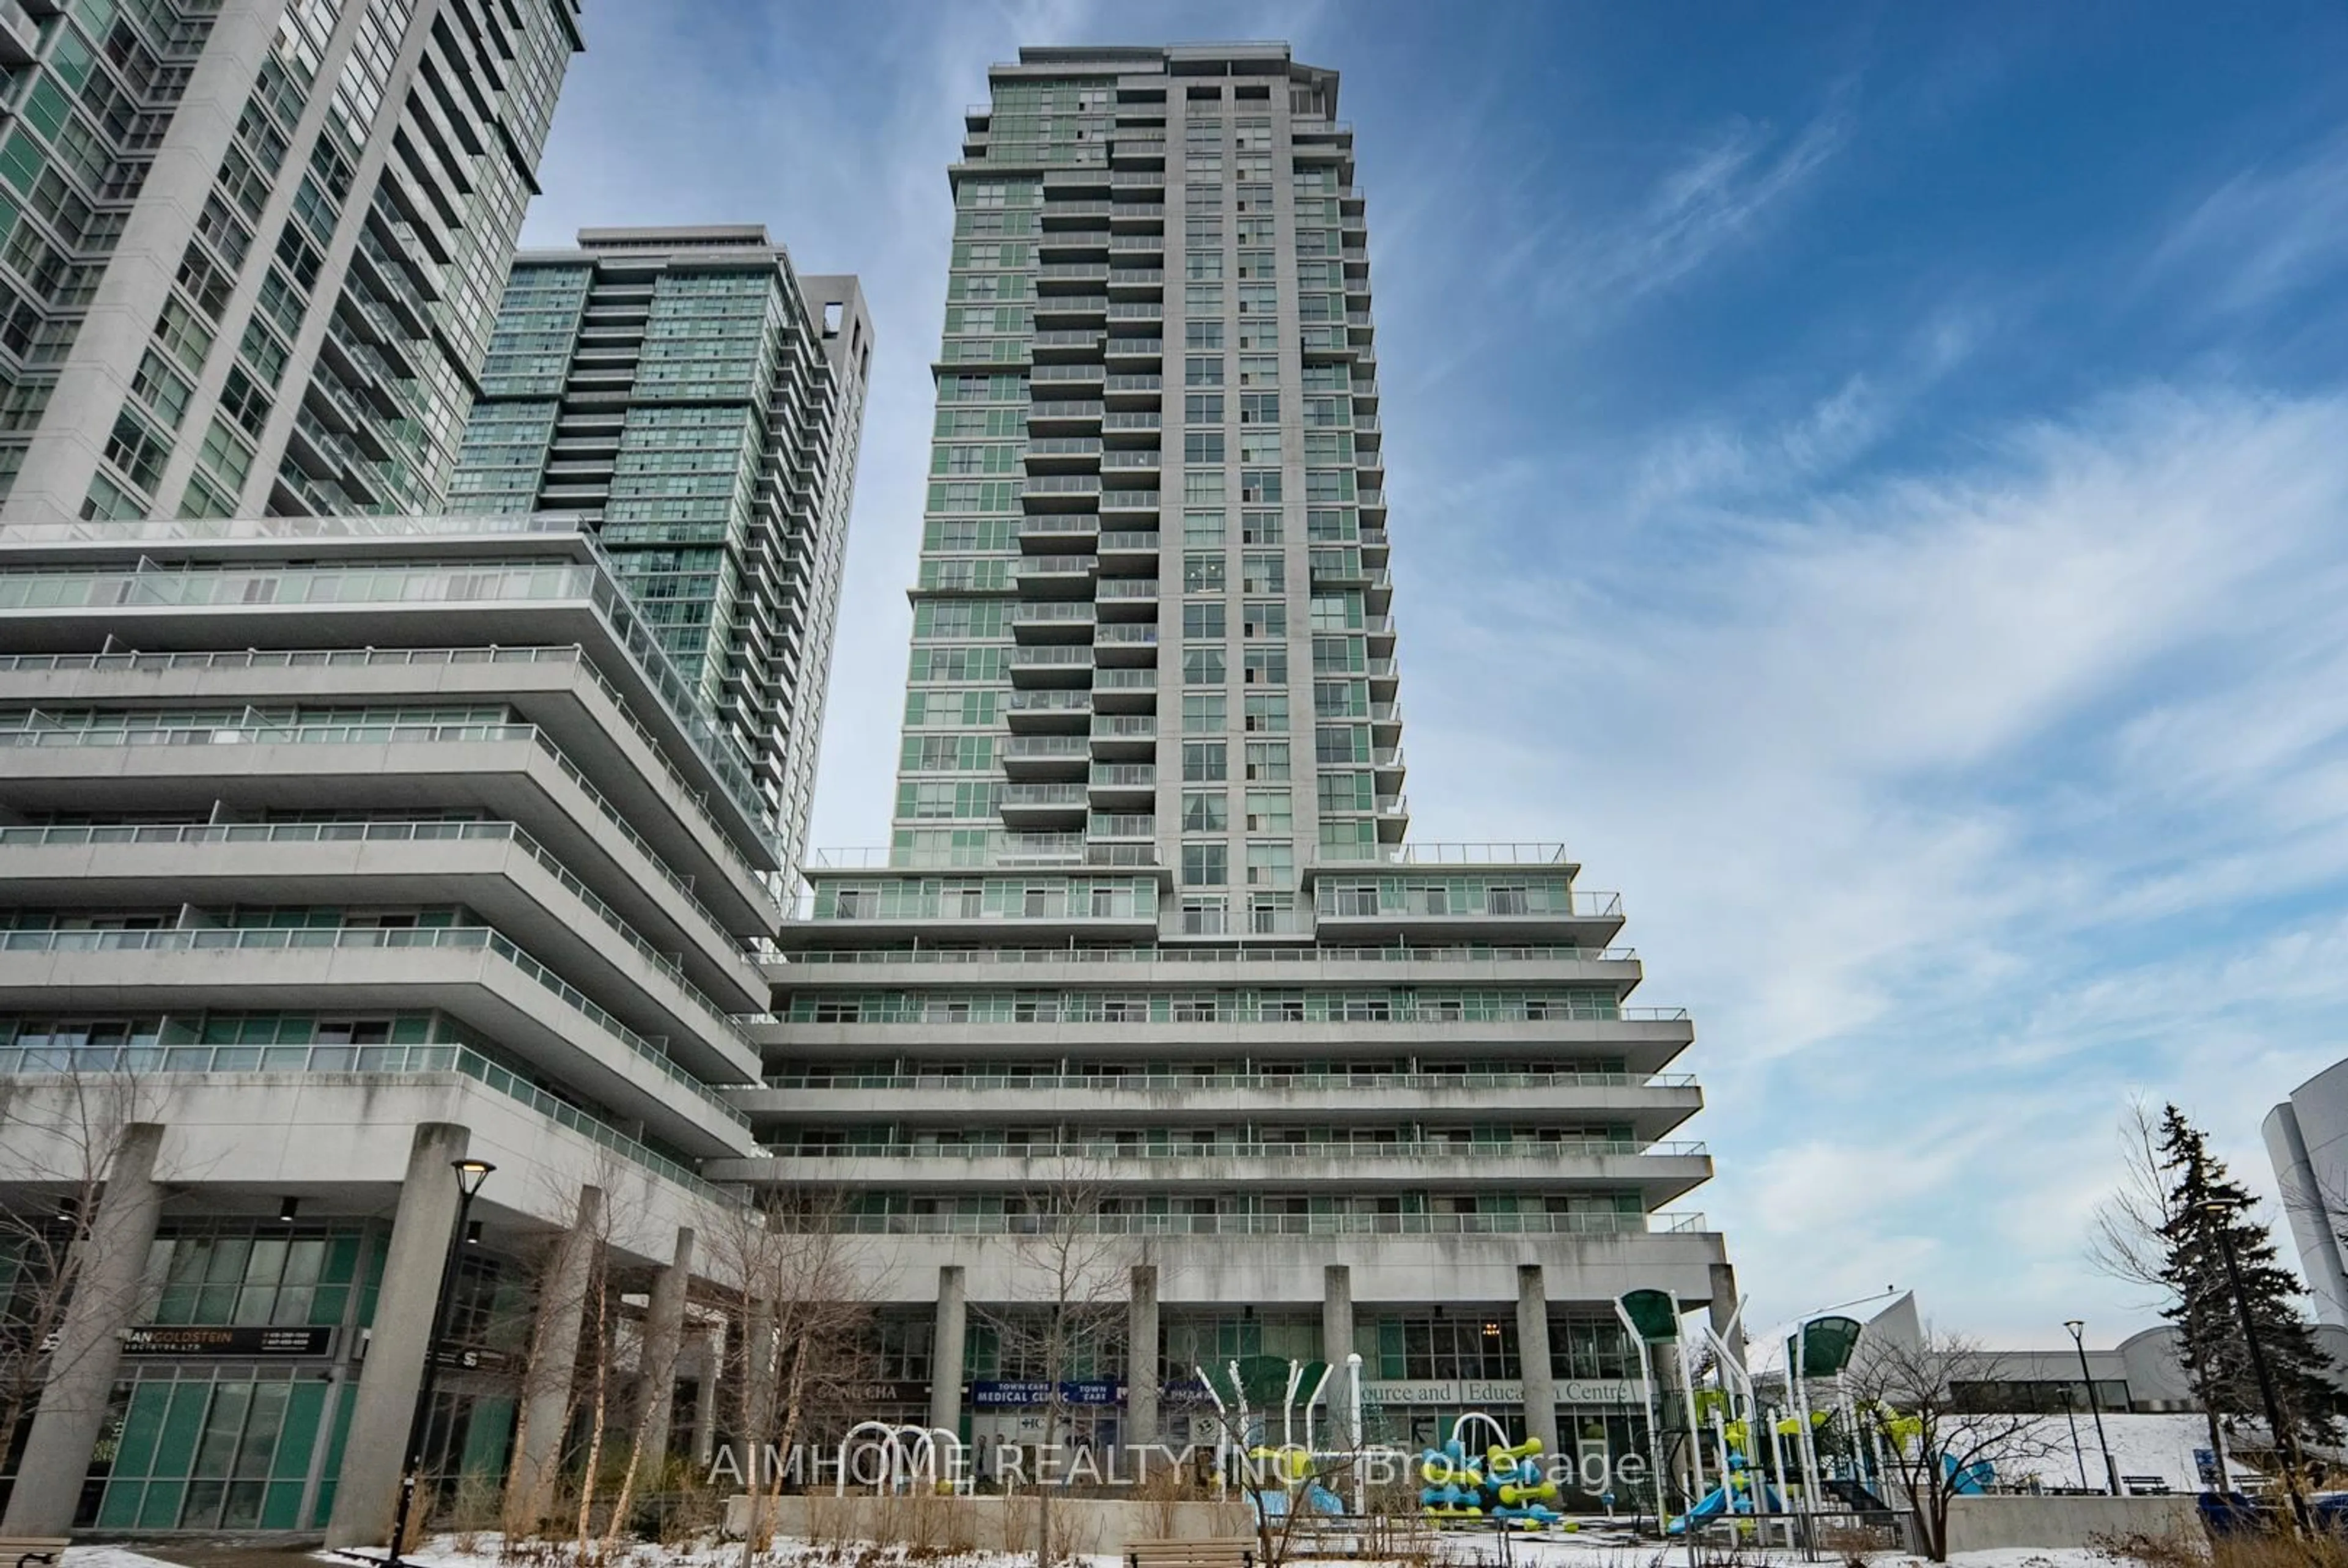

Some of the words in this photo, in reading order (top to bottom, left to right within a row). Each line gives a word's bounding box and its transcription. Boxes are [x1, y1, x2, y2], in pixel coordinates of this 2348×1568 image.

[978, 1392, 1028, 1402] MEDICAL
[1361, 1386, 1412, 1401] ource
[1419, 1383, 1451, 1401] and
[1566, 1382, 1627, 1401] Centre
